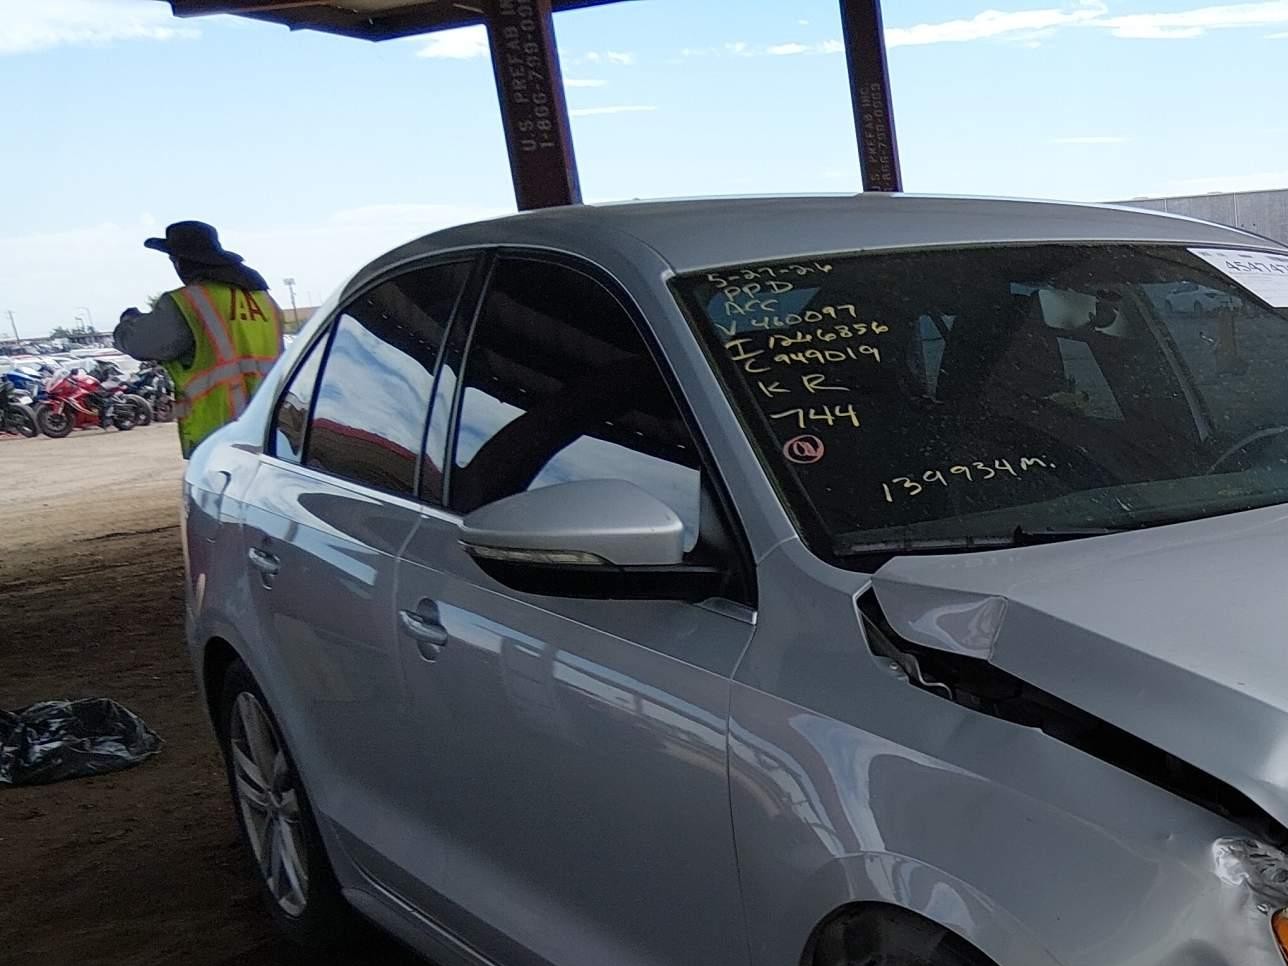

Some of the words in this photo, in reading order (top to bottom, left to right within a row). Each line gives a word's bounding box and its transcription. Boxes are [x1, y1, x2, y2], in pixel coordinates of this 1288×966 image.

[503, 26, 530, 104] PREFAB
[723, 281, 794, 301] PPD
[715, 320, 736, 336] V
[752, 305, 857, 329] 460097
[724, 299, 779, 316] ACC
[744, 359, 771, 373] C
[774, 345, 880, 365] 949019
